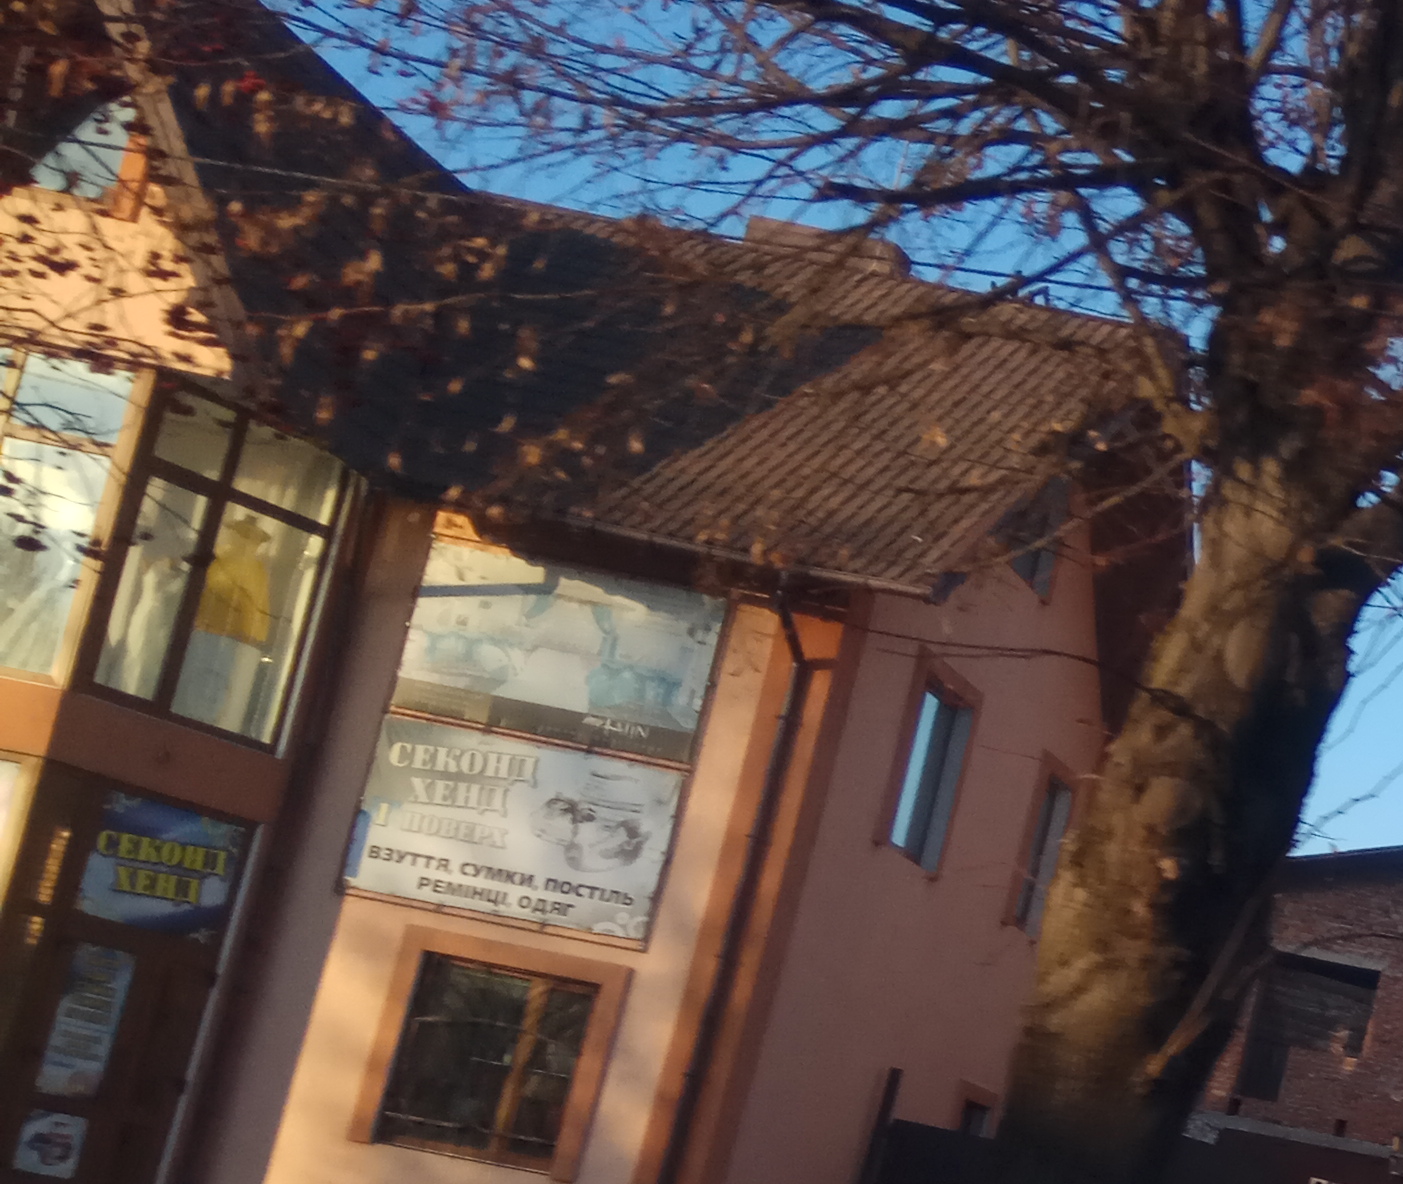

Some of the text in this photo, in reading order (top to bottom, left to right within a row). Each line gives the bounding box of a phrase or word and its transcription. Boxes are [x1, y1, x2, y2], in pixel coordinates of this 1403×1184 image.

[389, 741, 538, 788] СЕКОНД
[408, 777, 512, 818] ХЕНД
[401, 812, 507, 849] ПОВЕРХ
[98, 830, 227, 875] СЕКОНД
[115, 867, 200, 903] ХЕНД
[366, 845, 636, 907] ВЗУТТЯ, СУМКИ, ПОСТІЛЬ
[517, 893, 577, 918] ОДЯГ
